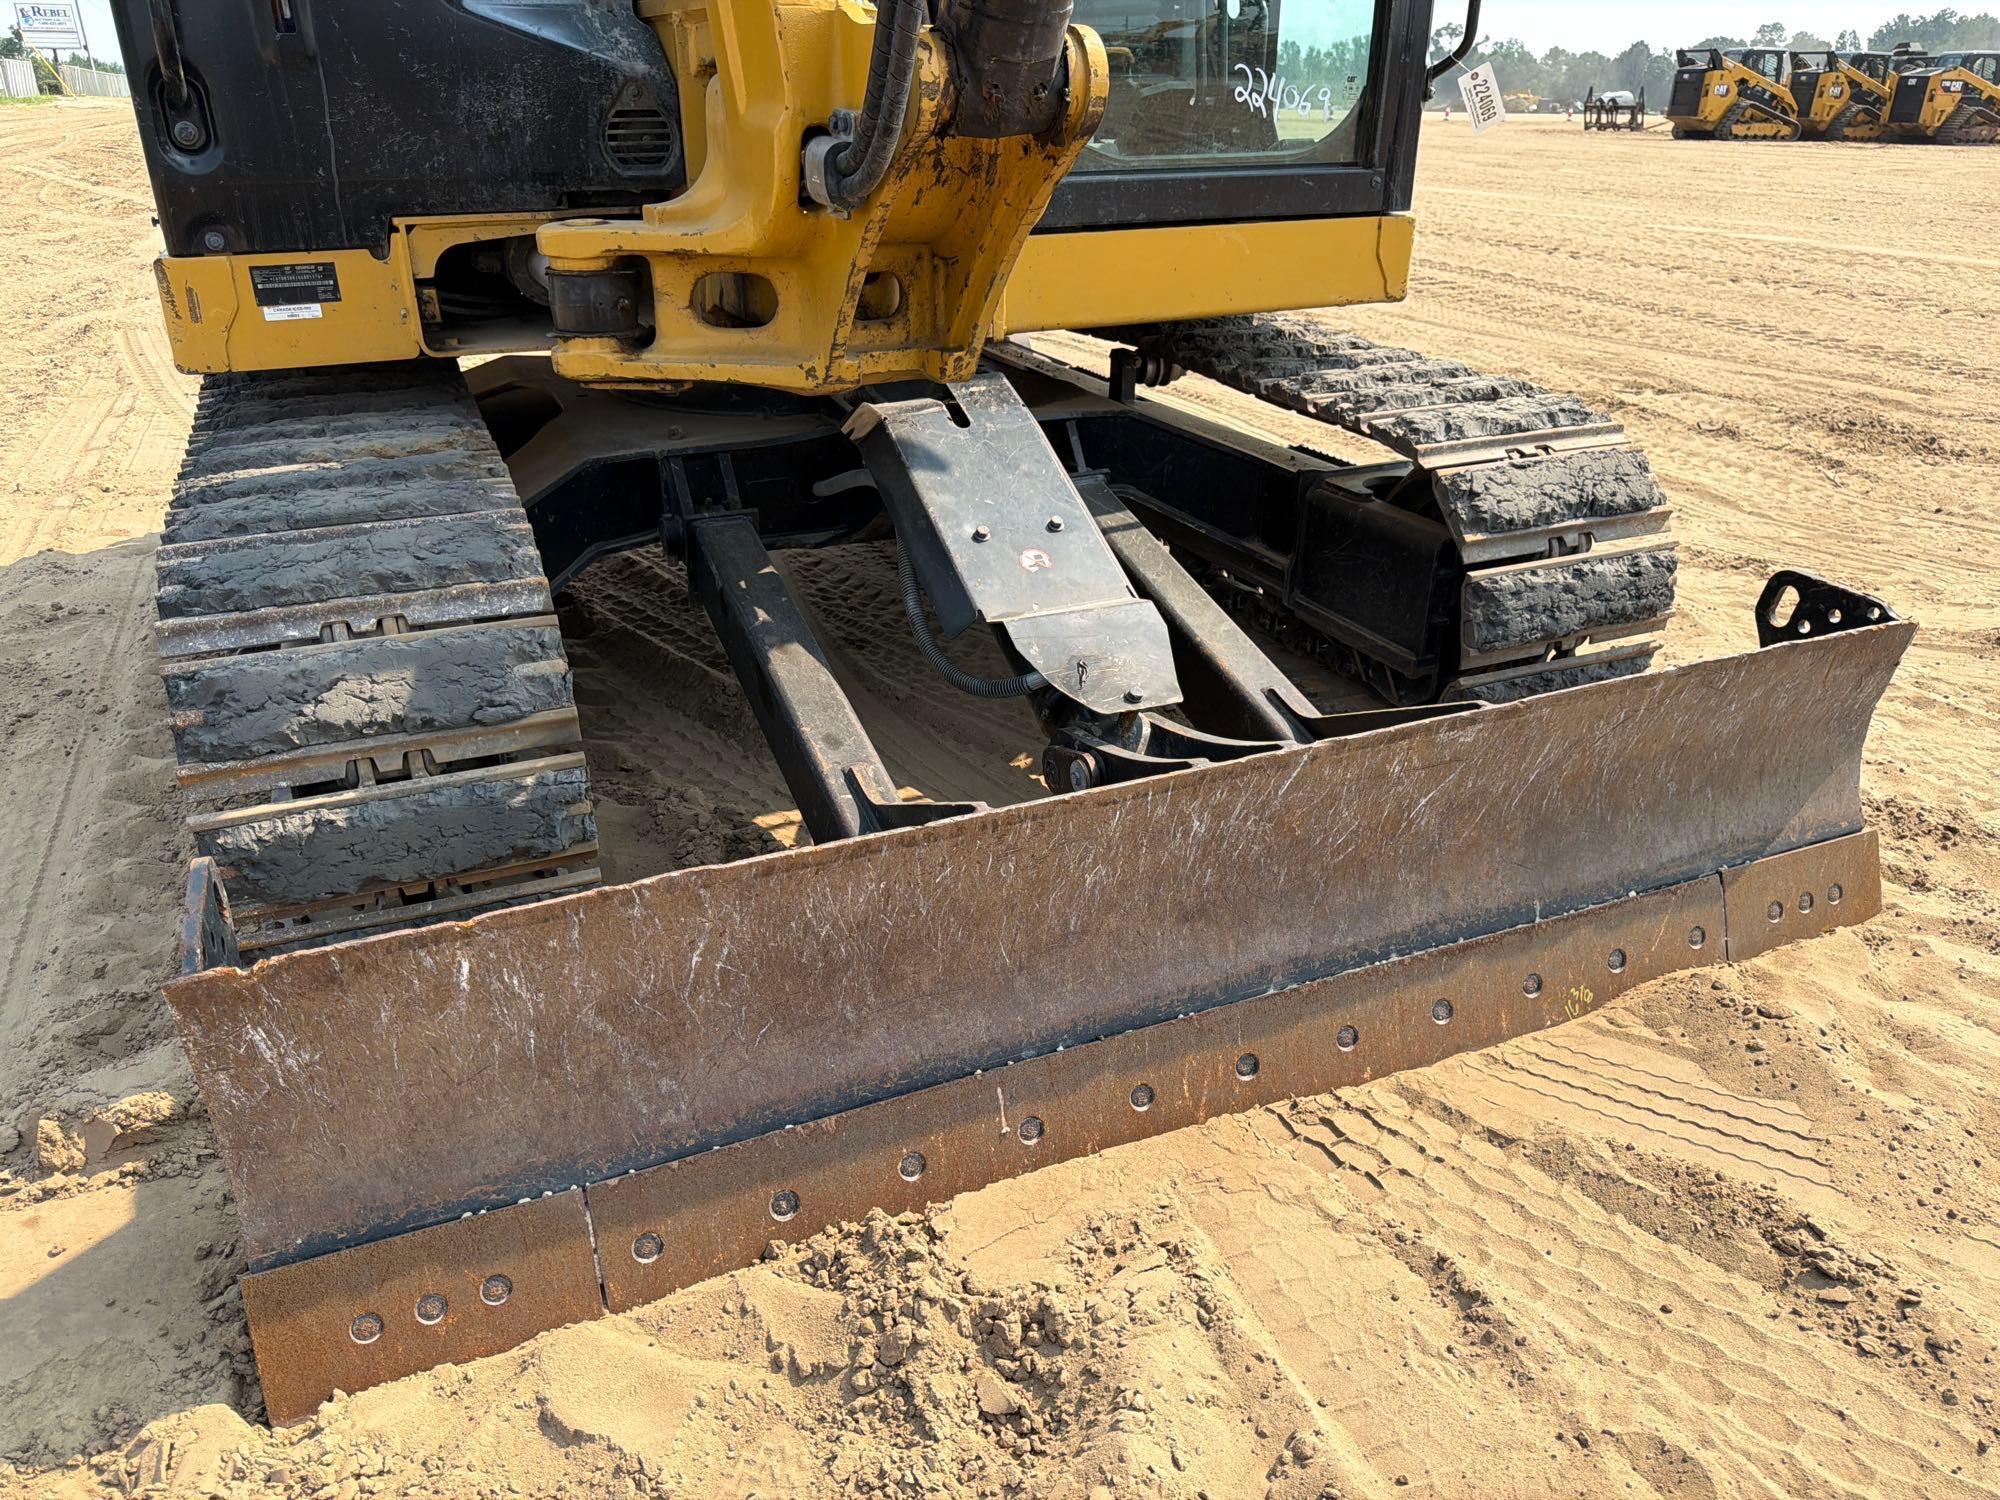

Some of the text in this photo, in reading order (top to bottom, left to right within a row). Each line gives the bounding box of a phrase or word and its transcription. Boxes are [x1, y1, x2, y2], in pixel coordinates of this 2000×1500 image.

[31, 6, 70, 17] REBEL
[1714, 84, 1728, 95] CAT
[1830, 86, 1842, 97] CAT
[1950, 81, 1964, 92] CAT
[1234, 63, 1331, 126] 224069
[1473, 79, 1497, 122] 224069
